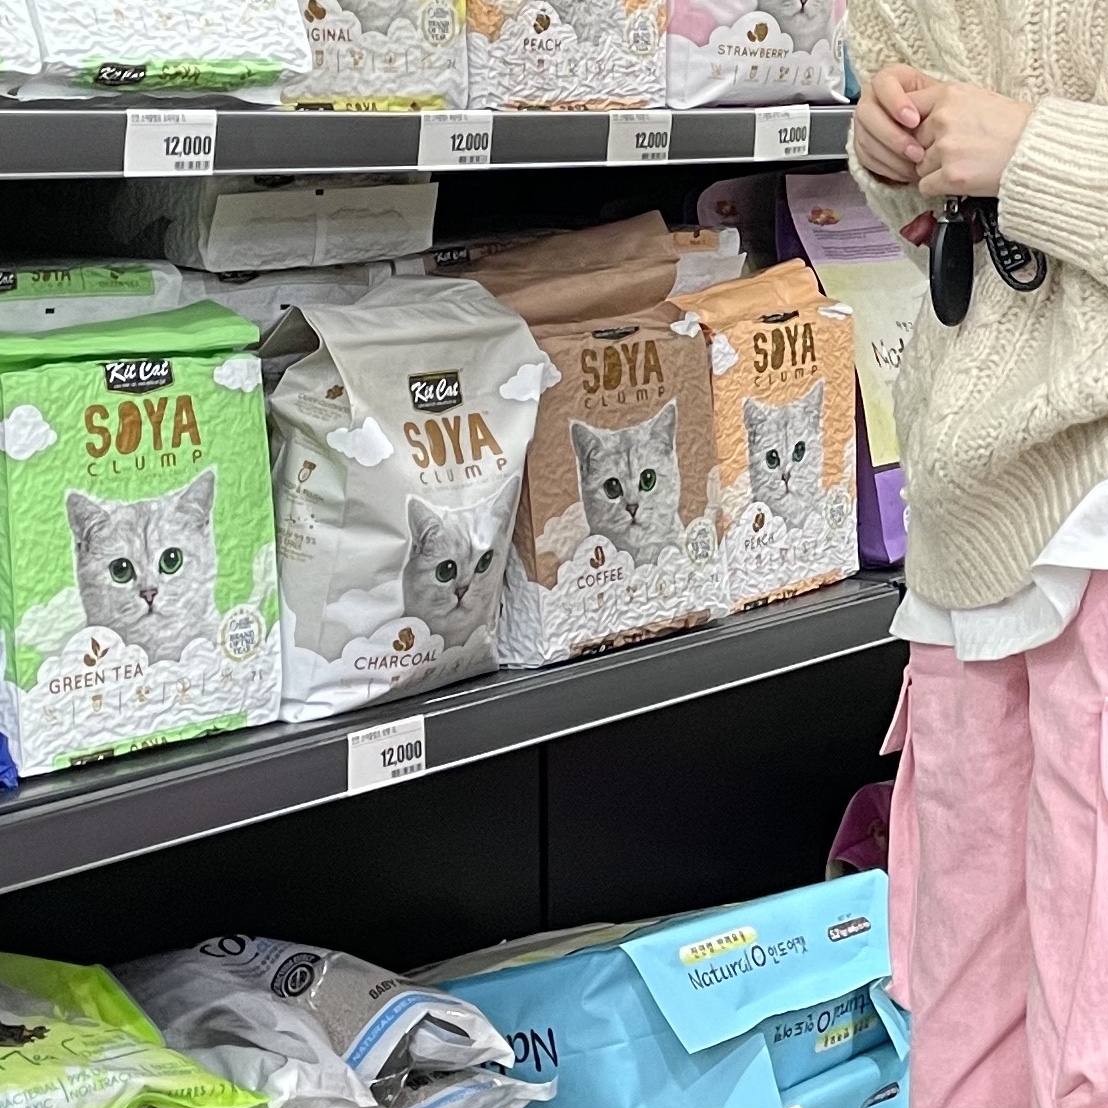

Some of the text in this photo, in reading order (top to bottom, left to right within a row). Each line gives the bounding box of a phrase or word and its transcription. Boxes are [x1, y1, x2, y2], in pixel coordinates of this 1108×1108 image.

[307, 27, 354, 42] IGINAL
[522, 38, 562, 52] PEACH
[717, 44, 790, 59] STRAWBERRY
[163, 135, 212, 158] 12,000
[450, 132, 490, 151] 12,000
[634, 131, 669, 149] 12,000
[778, 125, 808, 145] 12,000
[752, 322, 816, 374] SOYA
[106, 359, 170, 384] Kit Cat
[580, 340, 666, 395] SOYA
[753, 364, 819, 388] CLUMP
[410, 378, 459, 402] Kit Cat
[584, 385, 666, 410] CLUMP
[84, 394, 202, 459] SOYA
[403, 412, 504, 469] SOYA
[86, 449, 203, 478] CLUMP
[418, 456, 508, 486] CLUMP
[743, 532, 775, 550] PEACH
[576, 566, 624, 590] COFFEE
[353, 648, 438, 671] CHARCOAL
[49, 662, 145, 695] GREEN TEA
[380, 739, 423, 767] 12,000
